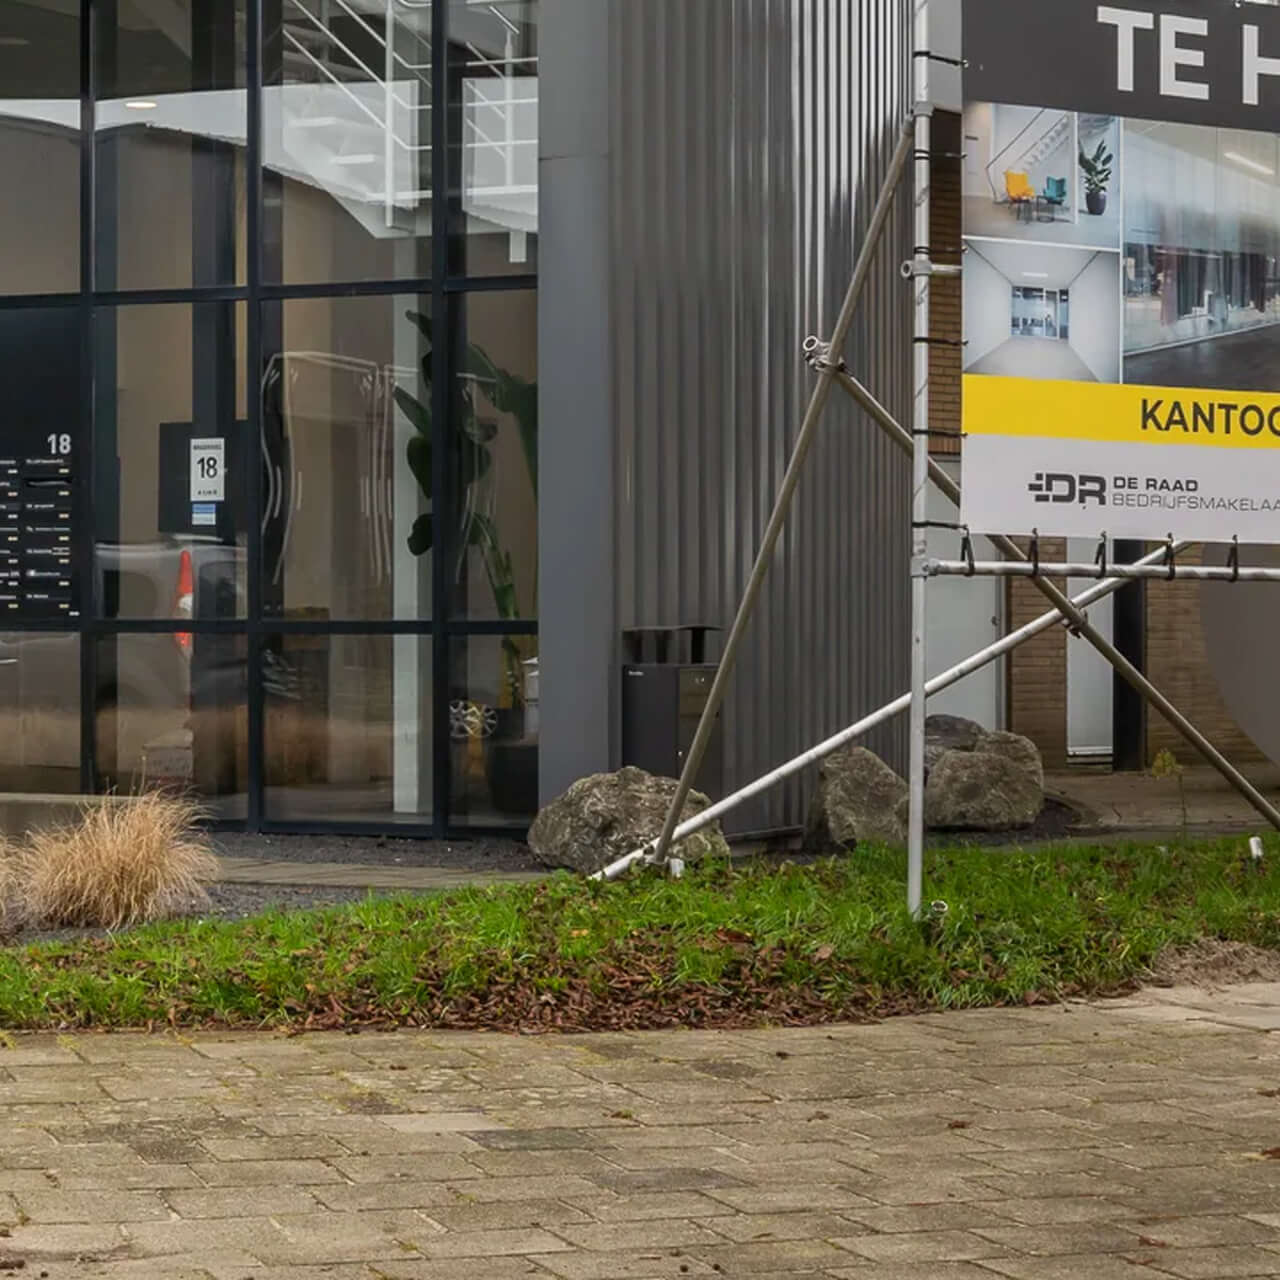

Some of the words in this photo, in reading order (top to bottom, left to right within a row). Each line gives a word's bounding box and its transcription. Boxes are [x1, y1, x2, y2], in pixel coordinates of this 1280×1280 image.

[1096, 5, 1210, 101] TE
[47, 433, 72, 455] 18
[196, 456, 218, 479] 18
[1113, 476, 1139, 490] DE
[1145, 477, 1199, 492] RAAD
